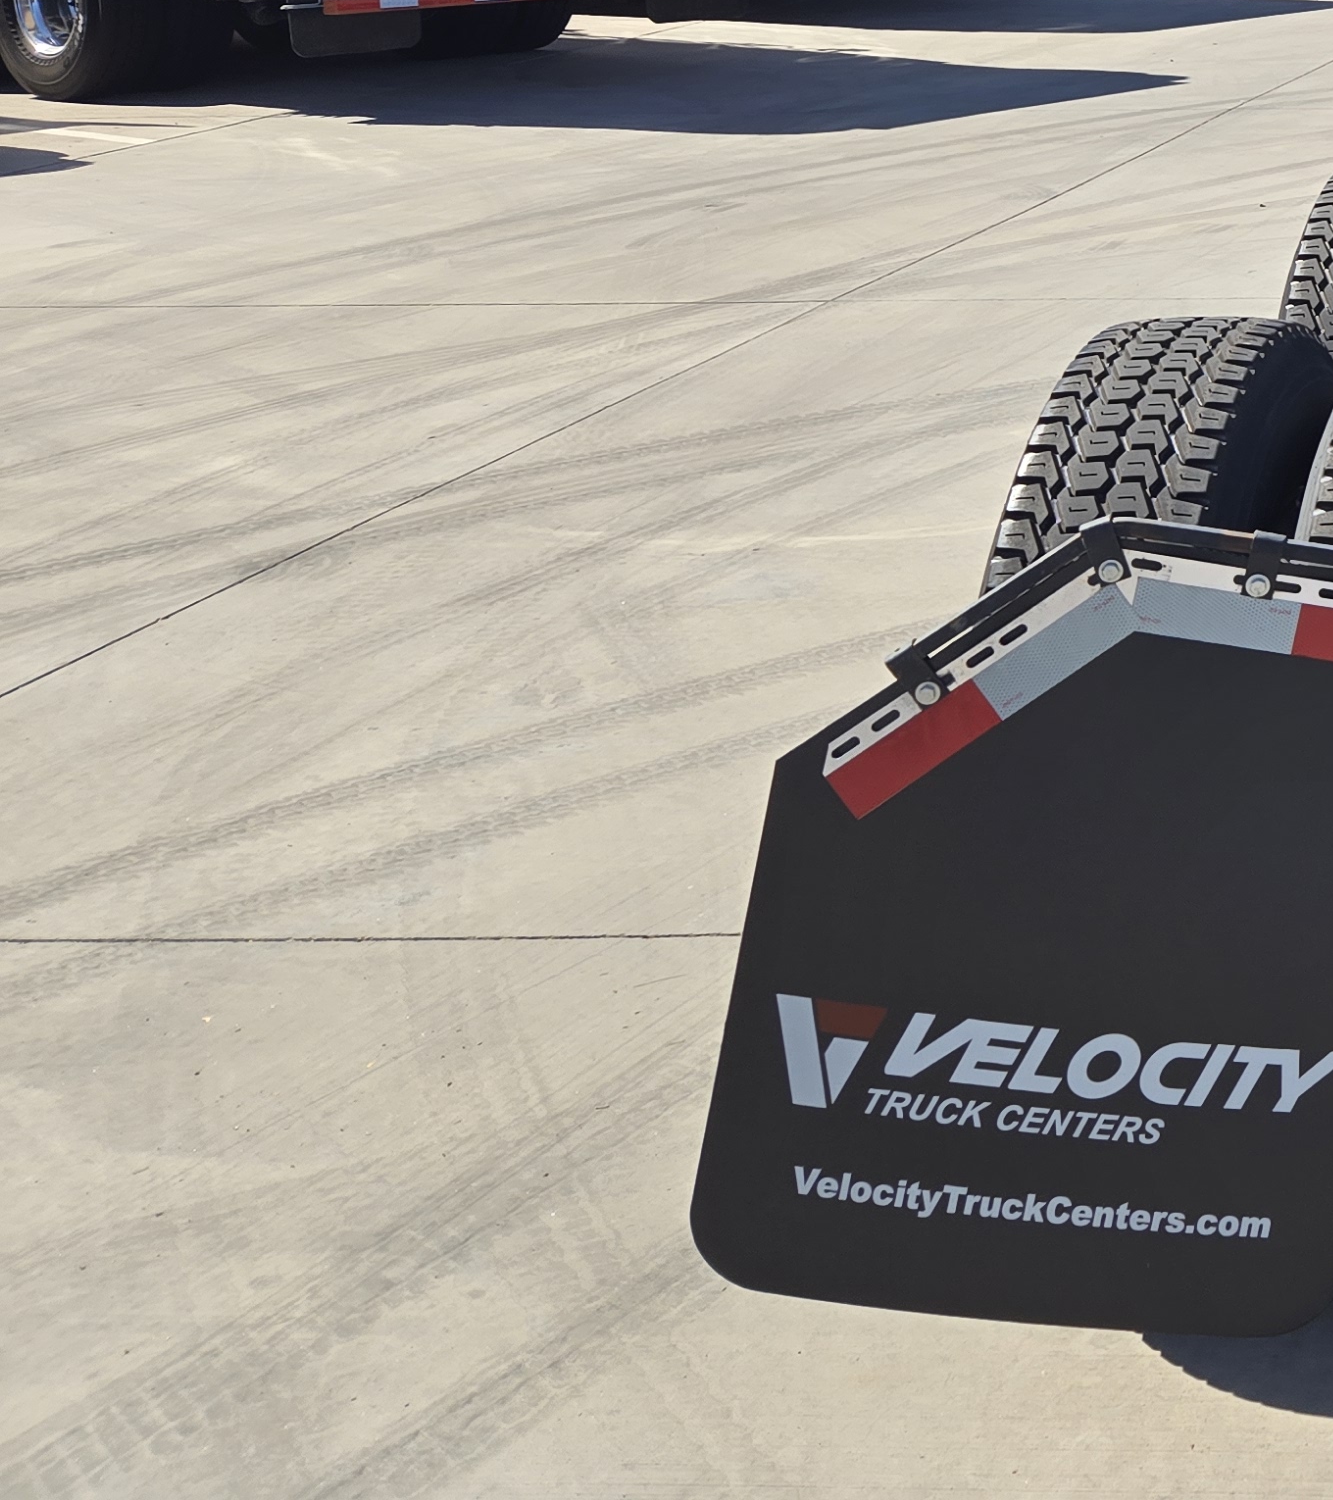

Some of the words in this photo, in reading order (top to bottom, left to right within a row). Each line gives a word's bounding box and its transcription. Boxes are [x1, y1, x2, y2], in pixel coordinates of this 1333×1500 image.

[864, 1087, 992, 1129] TRUCK
[996, 1104, 1165, 1146] CENTERS
[794, 1166, 1271, 1239] VelocityTruckCenters.com
